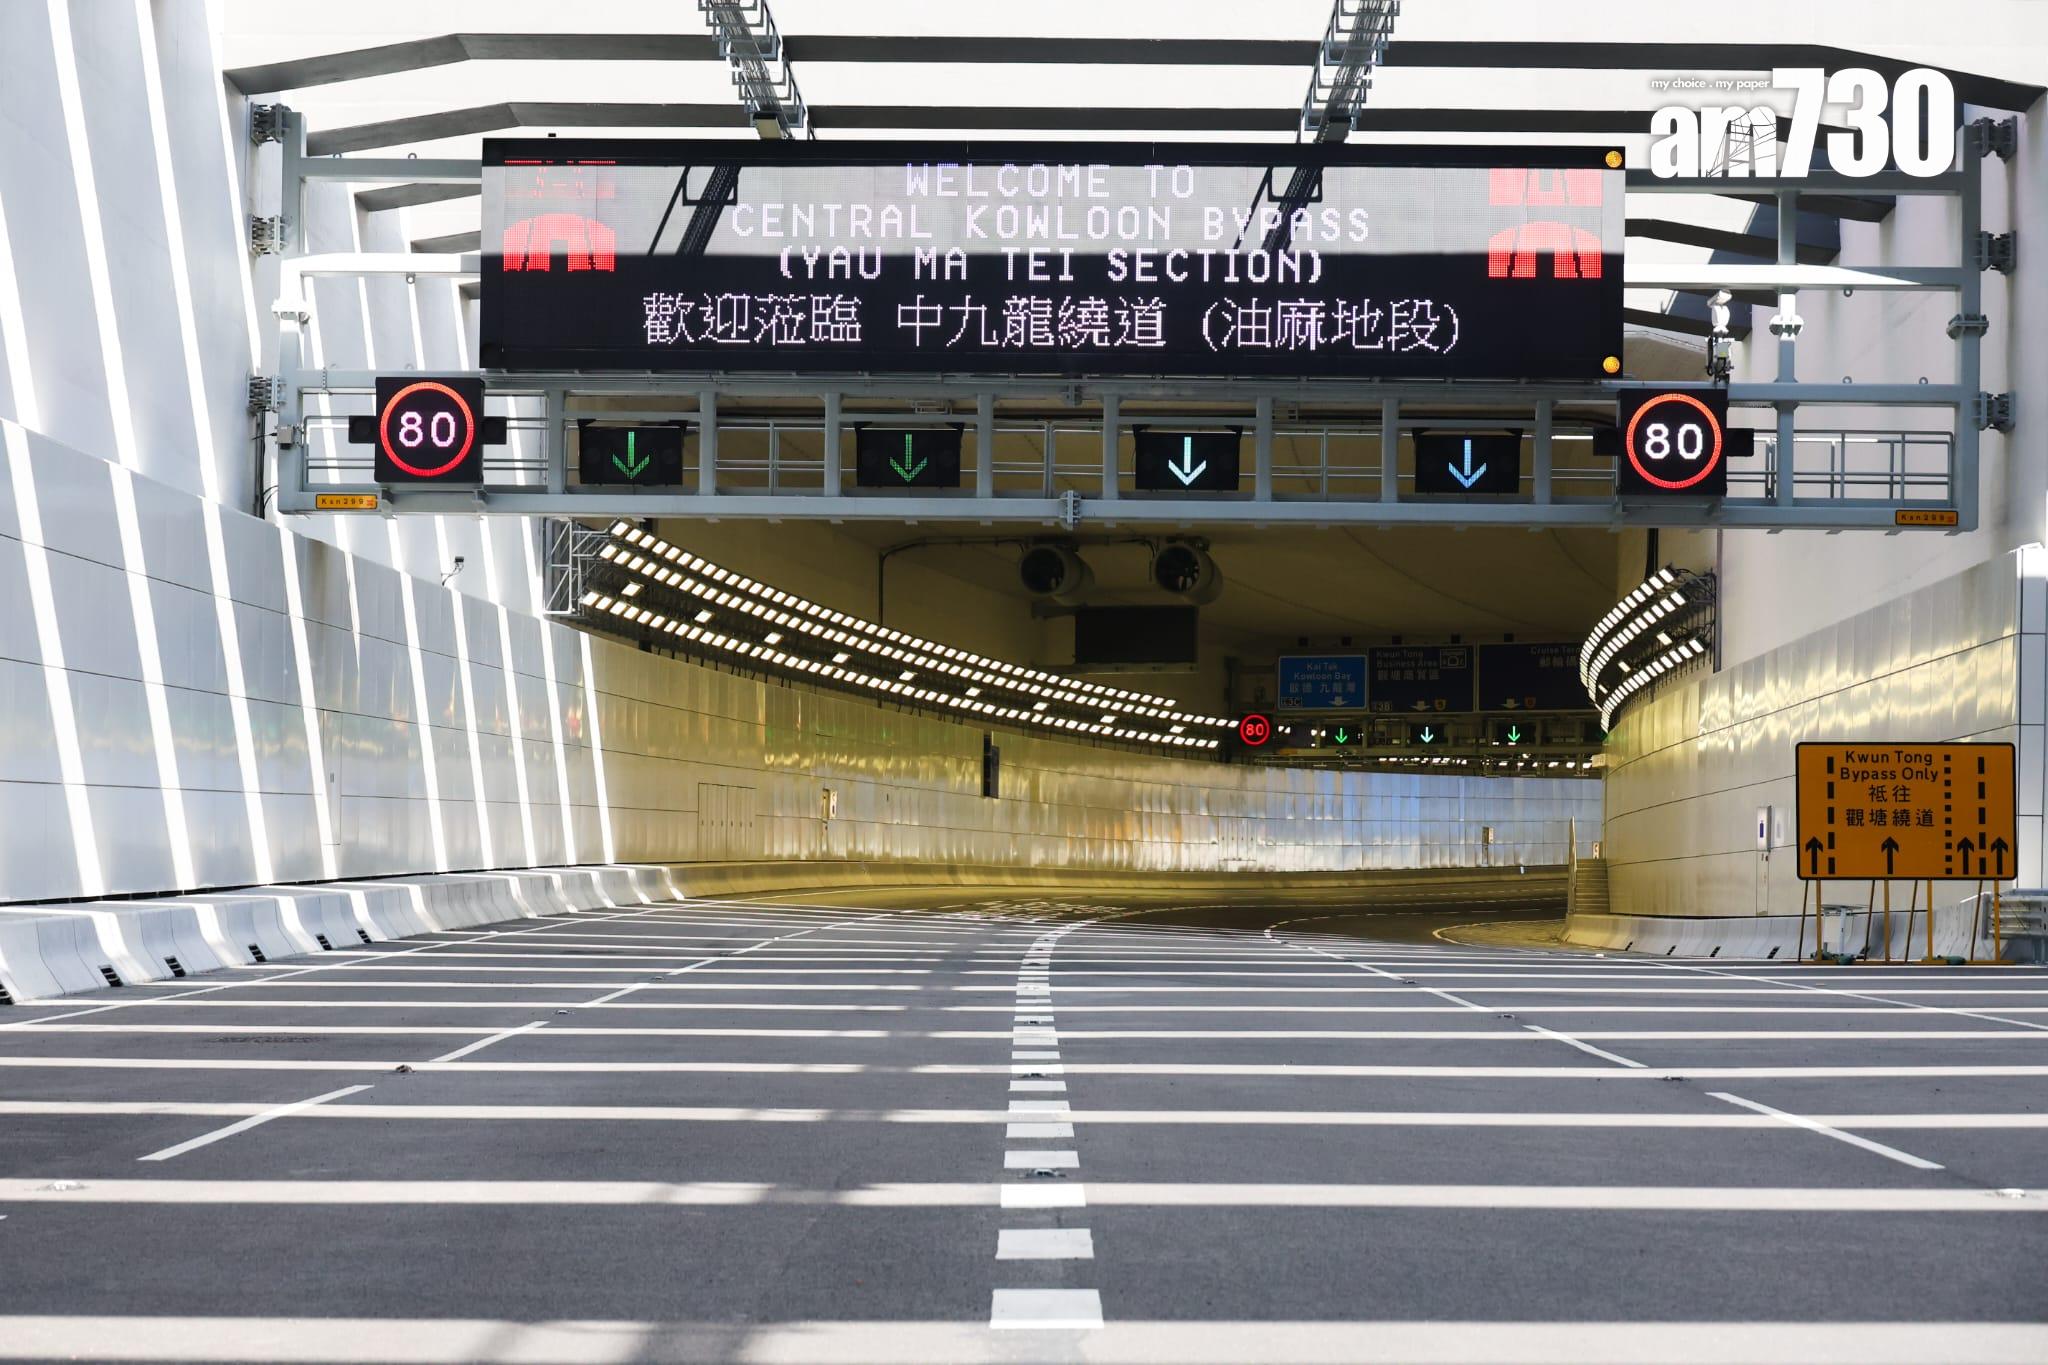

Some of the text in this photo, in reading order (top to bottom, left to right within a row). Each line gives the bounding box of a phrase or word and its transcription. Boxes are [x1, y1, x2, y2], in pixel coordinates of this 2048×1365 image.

[905, 162, 1195, 199] WELCOME TO
[731, 202, 1370, 242] CENTRAL KOWLOON BYPASS
[779, 244, 1323, 284] (YAU MA TEI SECTION)
[896, 293, 1168, 349] 中九龍繞道
[1201, 297, 1460, 354] (油麻地段)
[398, 411, 456, 448] 80
[1644, 422, 1704, 461] 80
[1294, 671, 1352, 682] Kowloon Bay
[1306, 662, 1339, 671] Kai Tak
[1245, 723, 1265, 736] 80
[1845, 750, 1933, 766] Kwun Tong
[1840, 767, 1939, 783] Bypass Only
[1845, 808, 1935, 827] 觀塘繞道
